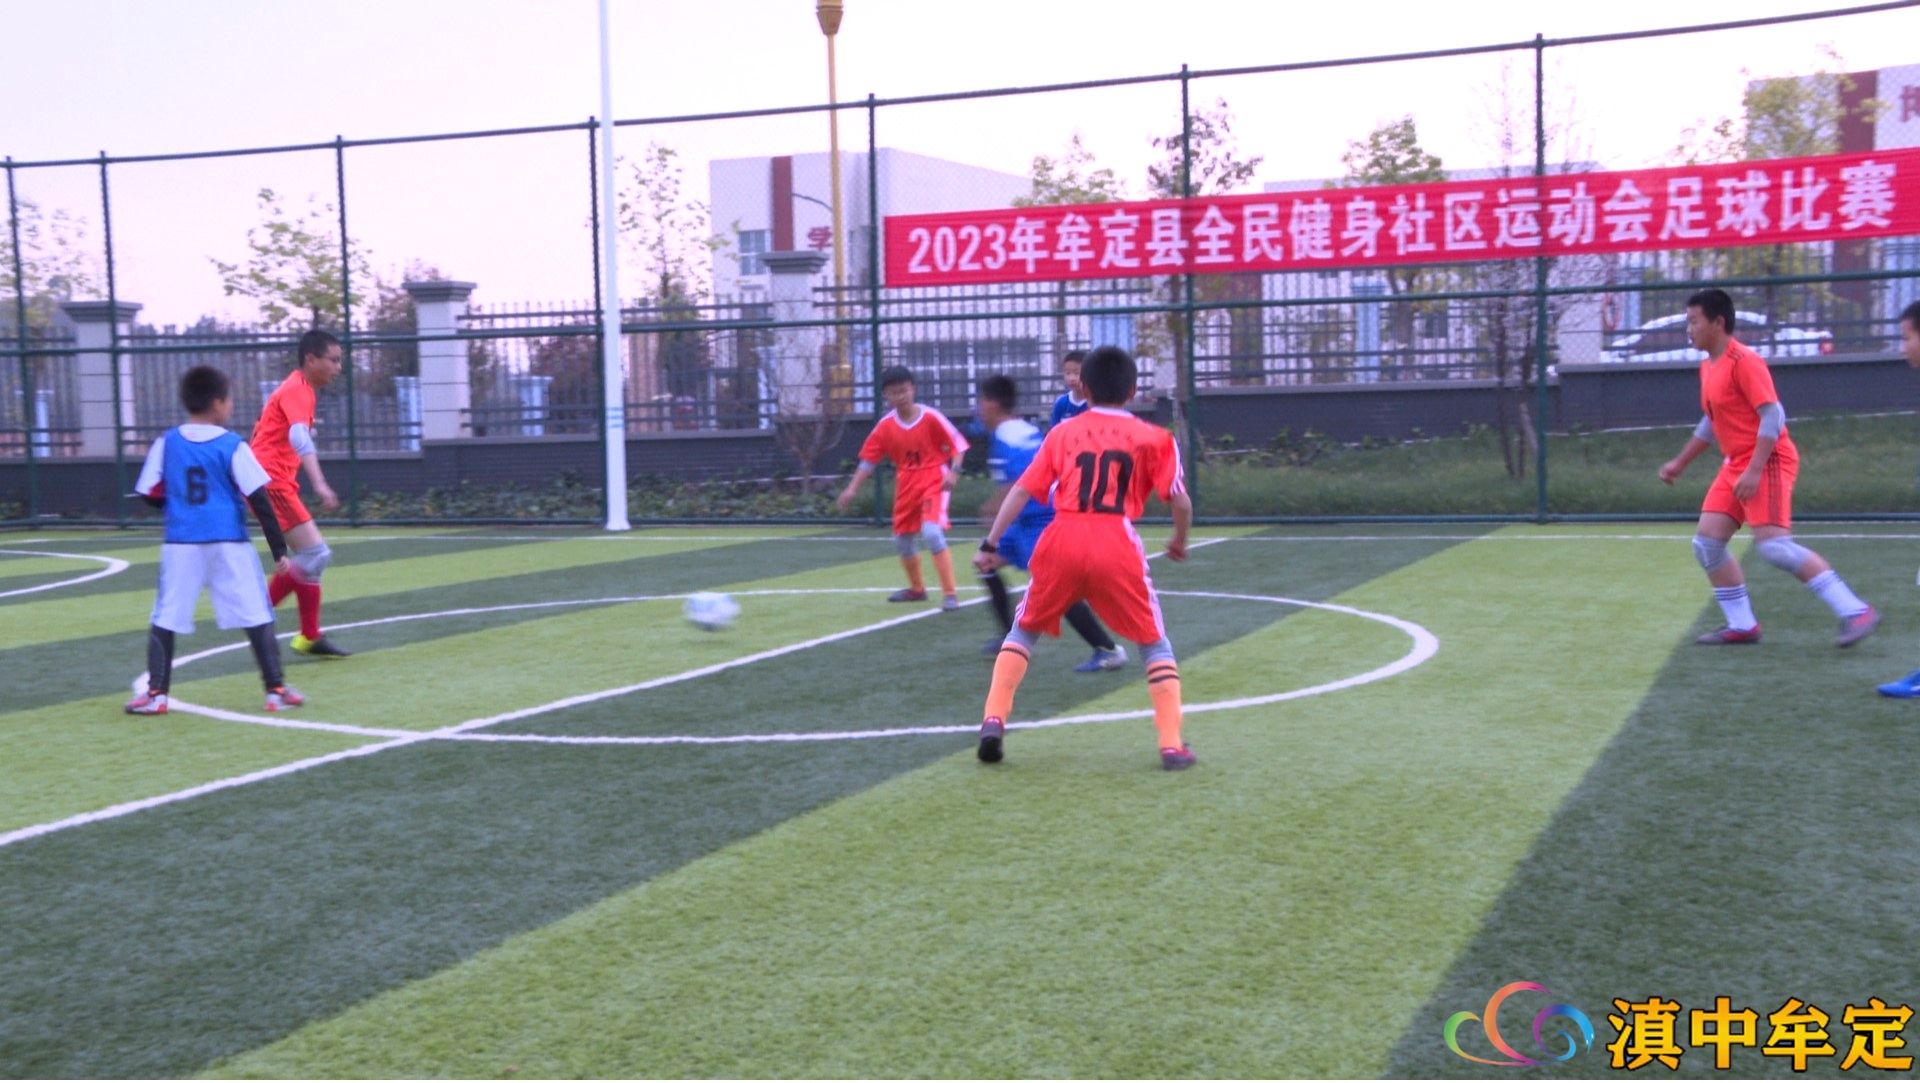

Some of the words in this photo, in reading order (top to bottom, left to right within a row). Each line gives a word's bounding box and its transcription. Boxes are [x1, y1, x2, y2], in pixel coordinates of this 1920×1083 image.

[907, 159, 1898, 275] 2023年牟定县全民健身社区运动会足球比赛
[186, 464, 208, 506] 6
[1075, 449, 1134, 513] 10
